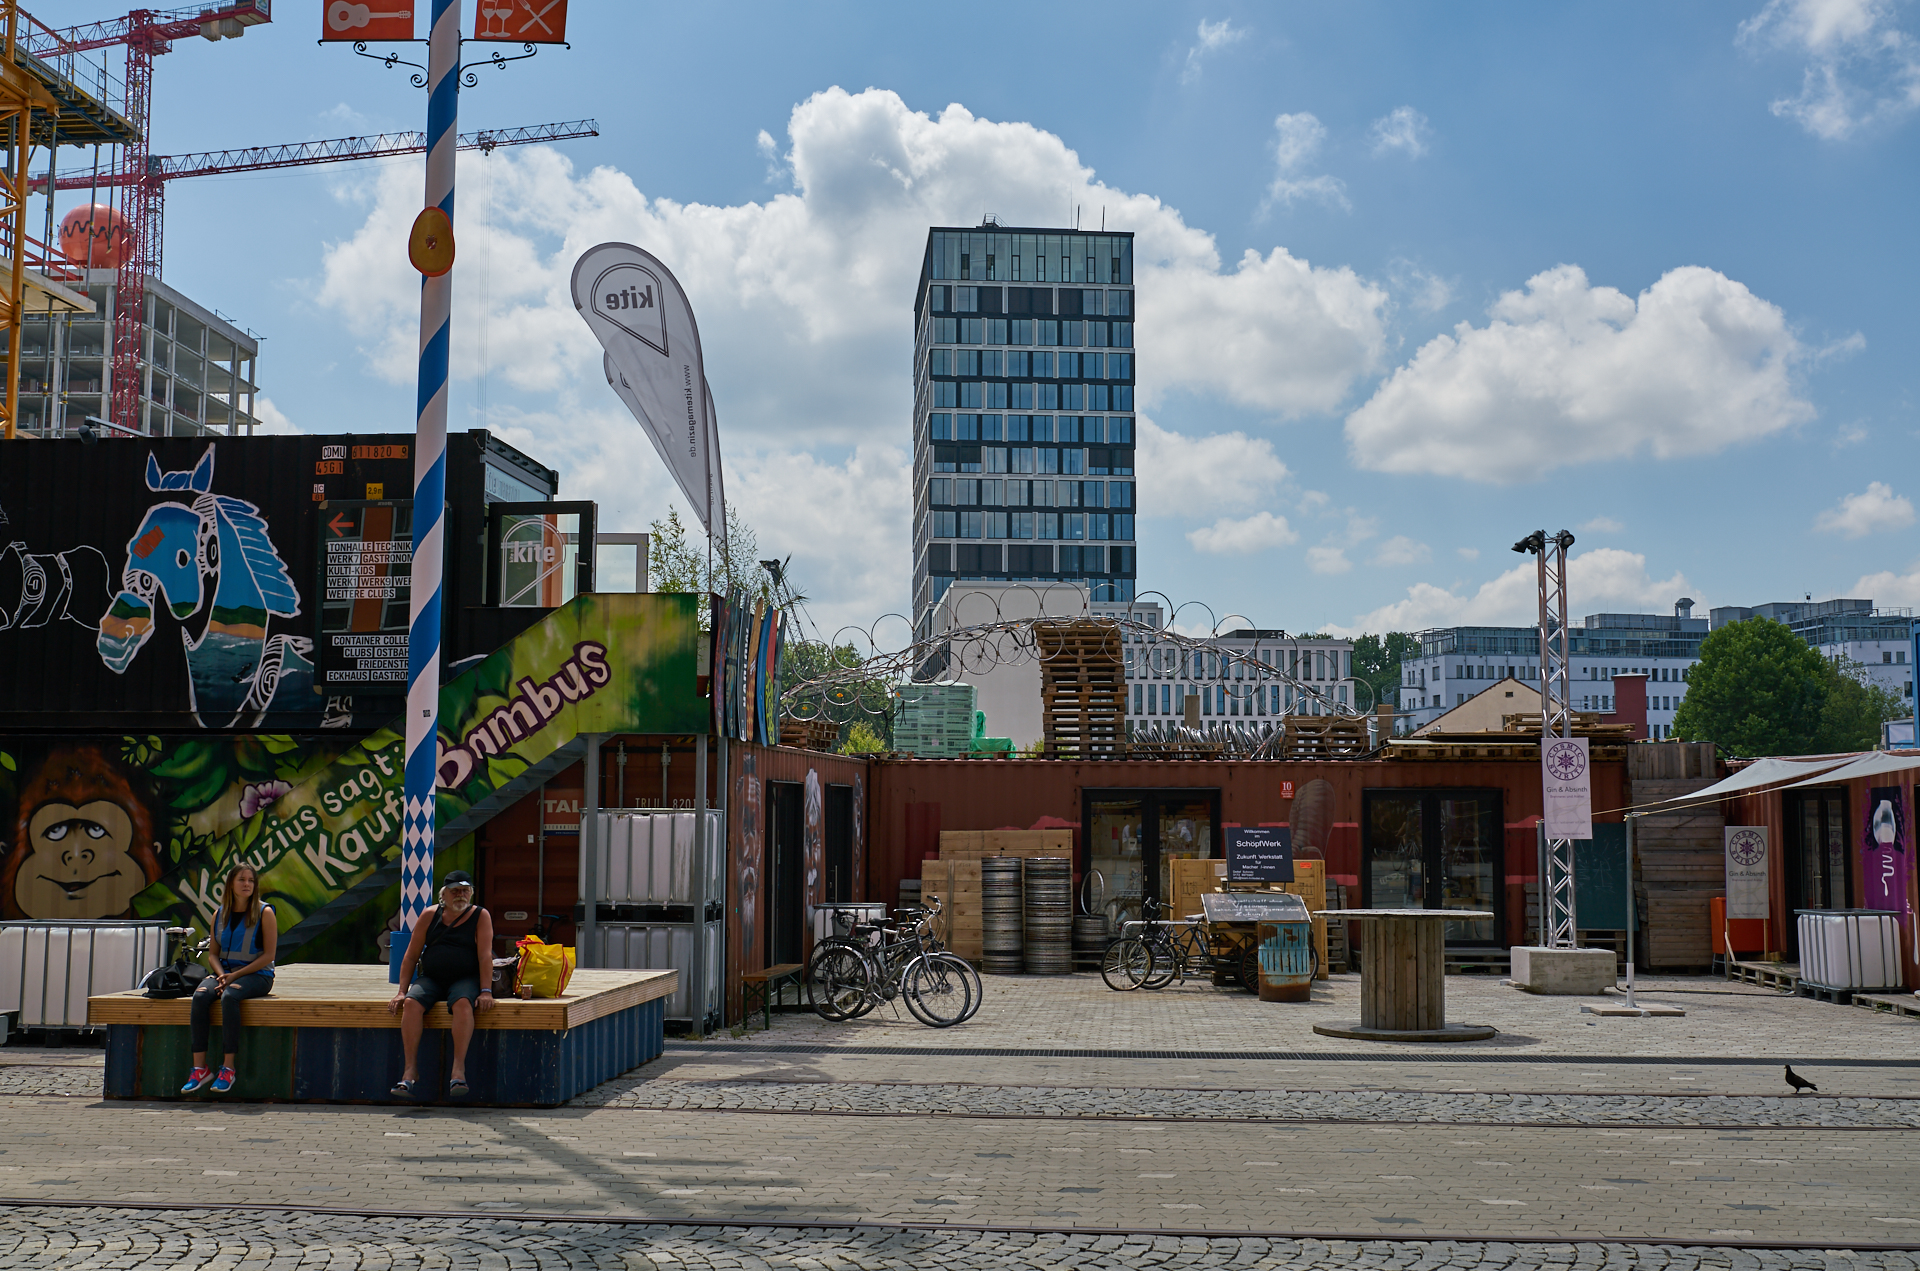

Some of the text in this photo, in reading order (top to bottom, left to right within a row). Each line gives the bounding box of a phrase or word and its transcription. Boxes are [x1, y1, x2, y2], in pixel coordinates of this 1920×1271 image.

[323, 446, 346, 458] CDMU
[352, 445, 392, 458] 611820
[316, 462, 342, 474] 45G1
[329, 542, 412, 551] TONHALLE TECHNIK
[513, 541, 555, 563] kite
[328, 554, 359, 563] WERK7
[328, 566, 374, 575] KULTI-KIDS
[328, 577, 357, 586] WERK1
[360, 577, 391, 586] WERK9
[328, 589, 395, 598] WEITERE CLUBS
[333, 636, 409, 645] CONTAINER COLLE
[344, 648, 372, 657] CLUBS
[328, 671, 367, 681] ECKHAUS
[1548, 742, 1583, 759] COSMIC
[1548, 763, 1584, 780] SPIRITS
[1282, 782, 1292, 791] 10
[544, 799, 580, 813] TAL
[303, 786, 405, 887] Kauf
[1236, 840, 1281, 848] SchöpfWerk
[178, 809, 317, 926] Kouzius
